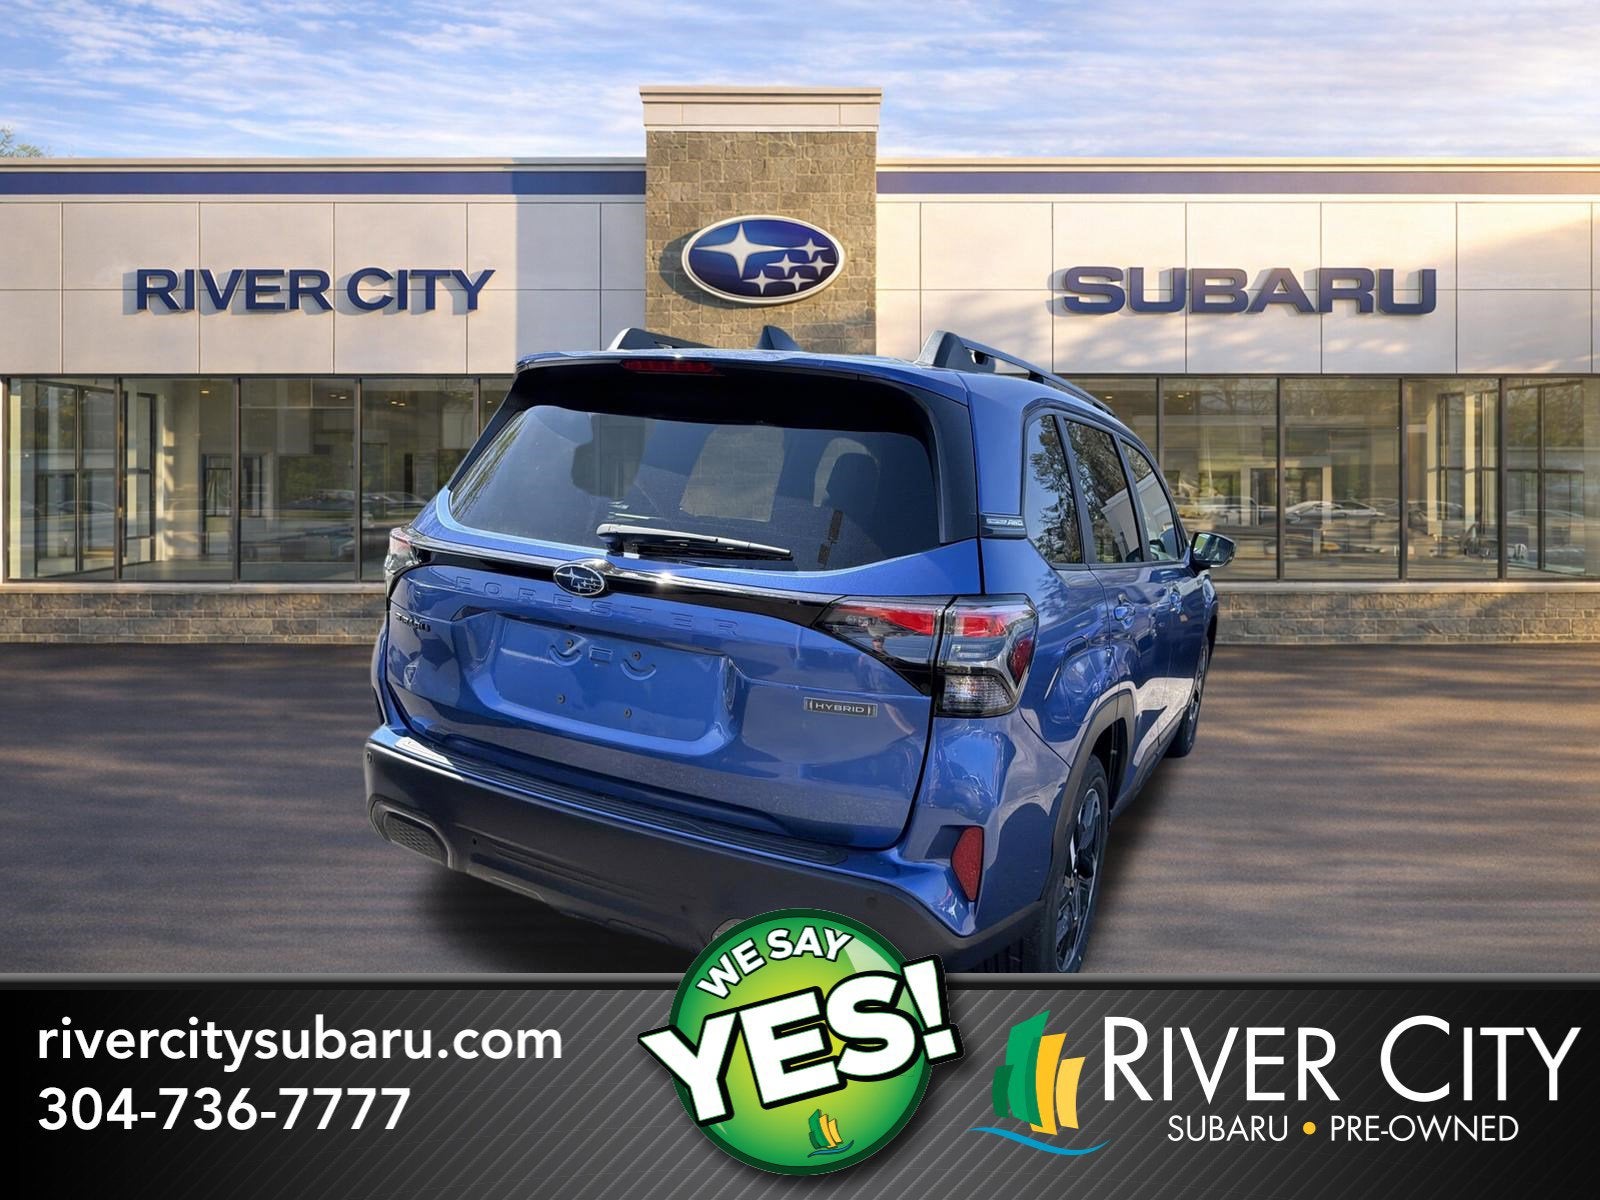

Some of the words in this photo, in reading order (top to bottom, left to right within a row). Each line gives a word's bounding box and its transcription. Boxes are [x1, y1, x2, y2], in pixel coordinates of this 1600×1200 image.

[135, 267, 334, 311] RIVER
[345, 266, 496, 311] CITY
[1063, 265, 1437, 314] SUBARU
[455, 575, 739, 637] FORESTER
[815, 702, 865, 713] HYBRID
